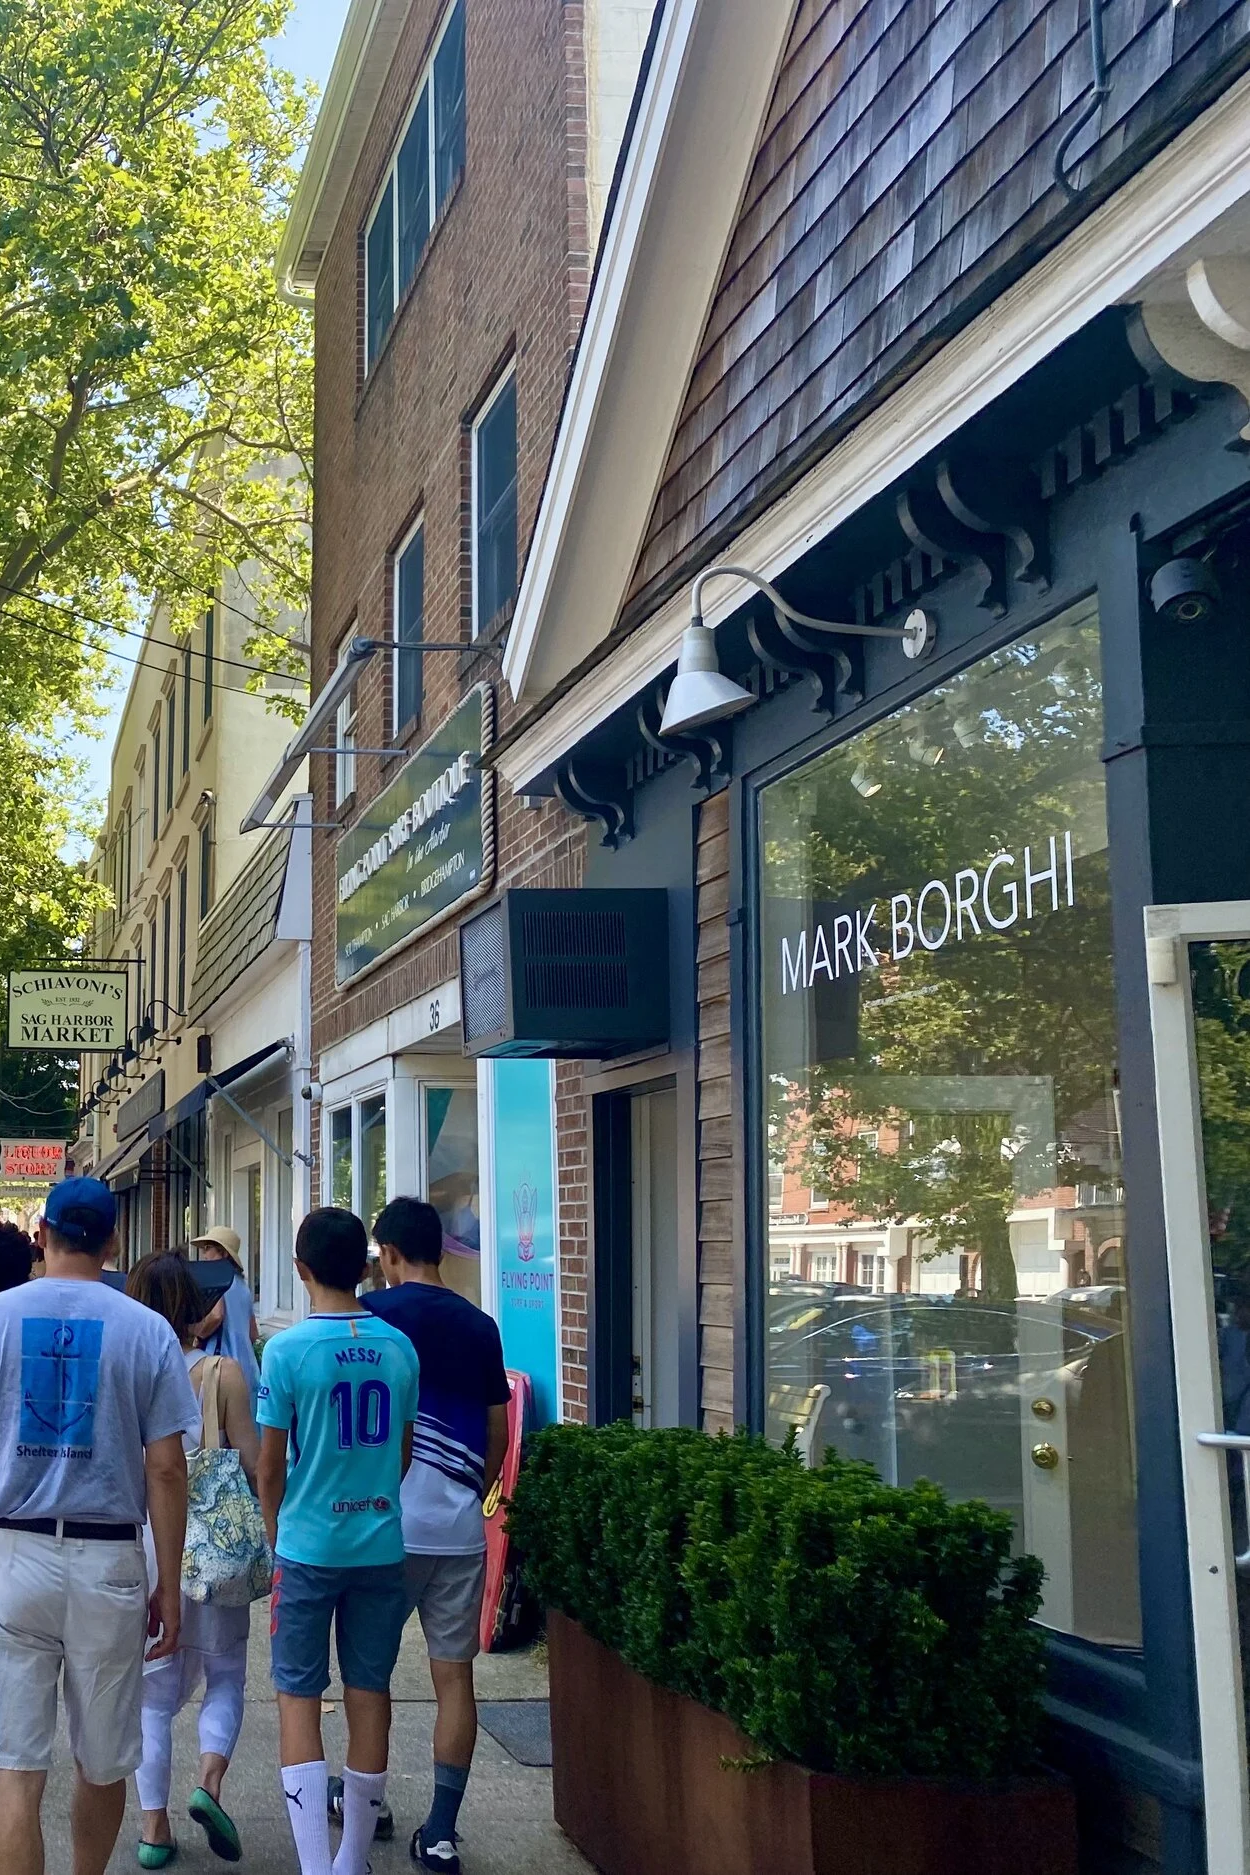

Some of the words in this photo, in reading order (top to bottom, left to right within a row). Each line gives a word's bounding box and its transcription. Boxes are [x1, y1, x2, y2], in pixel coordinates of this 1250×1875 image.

[412, 750, 472, 833] BOUTIQUE
[420, 848, 465, 898] BRIDGEHAMPTON
[781, 903, 879, 995] MARK
[891, 830, 1074, 961] BORGHI
[12, 976, 123, 1000] SCHIAVONI'S
[20, 1013, 47, 1025] SAG
[51, 1014, 113, 1027] HARBOR
[429, 999, 440, 1032] 36
[21, 1026, 115, 1043] MARKET
[3, 1145, 64, 1160] LIQUOR
[5, 1162, 58, 1176] STORE
[502, 1271, 528, 1289] FLYING
[530, 1273, 554, 1291] POINT
[334, 1347, 383, 1367] MESSI
[329, 1379, 392, 1450] 10
[16, 1445, 58, 1458] Shelter
[60, 1446, 93, 1459] Island
[332, 1497, 373, 1513] unicef
